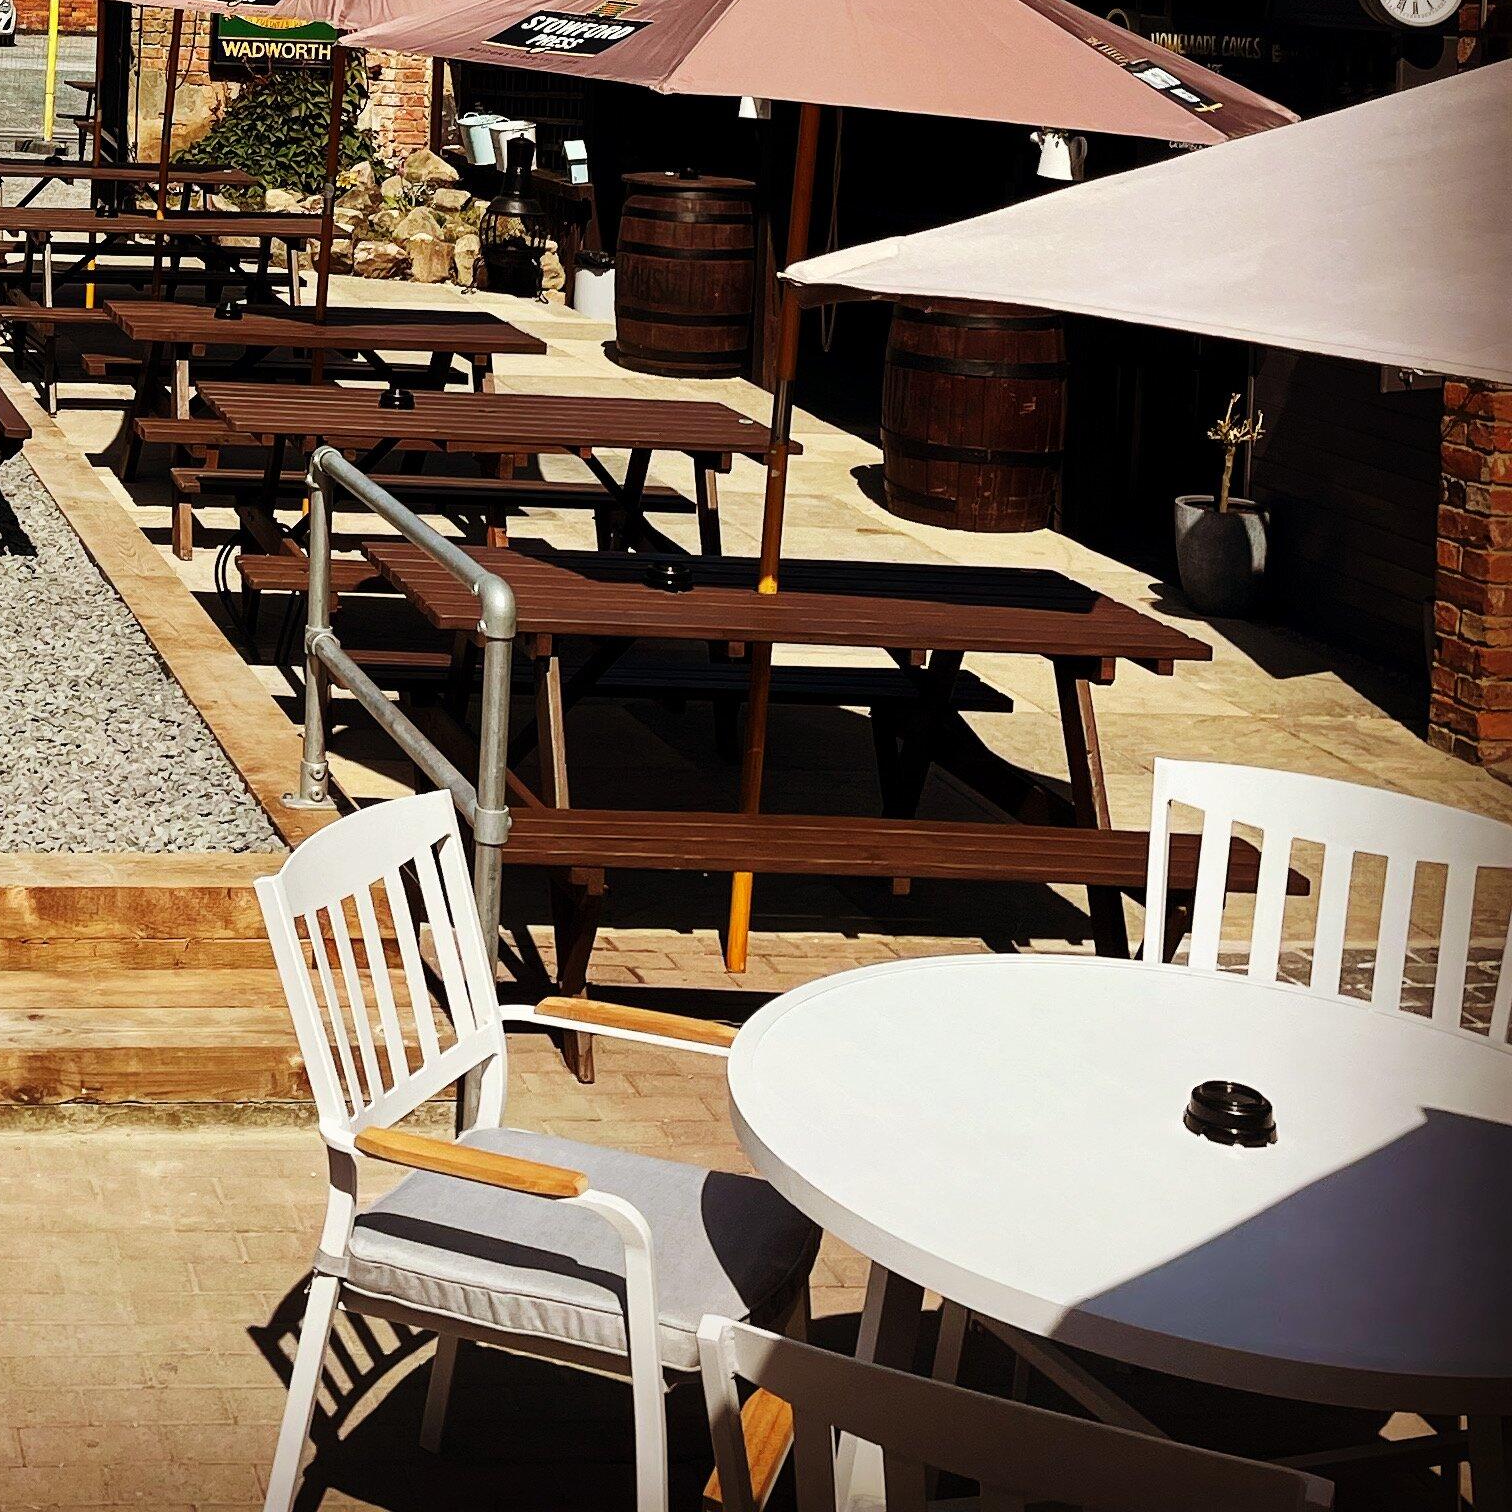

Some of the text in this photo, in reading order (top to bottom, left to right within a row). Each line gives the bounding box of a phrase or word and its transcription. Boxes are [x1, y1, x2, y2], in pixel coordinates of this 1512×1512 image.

[520, 15, 636, 40] STOWFORD
[221, 40, 332, 61] WADWORTH
[525, 33, 585, 50] PRESS
[1150, 32, 1218, 56] HOMEMADE
[1221, 36, 1262, 60] CAKES
